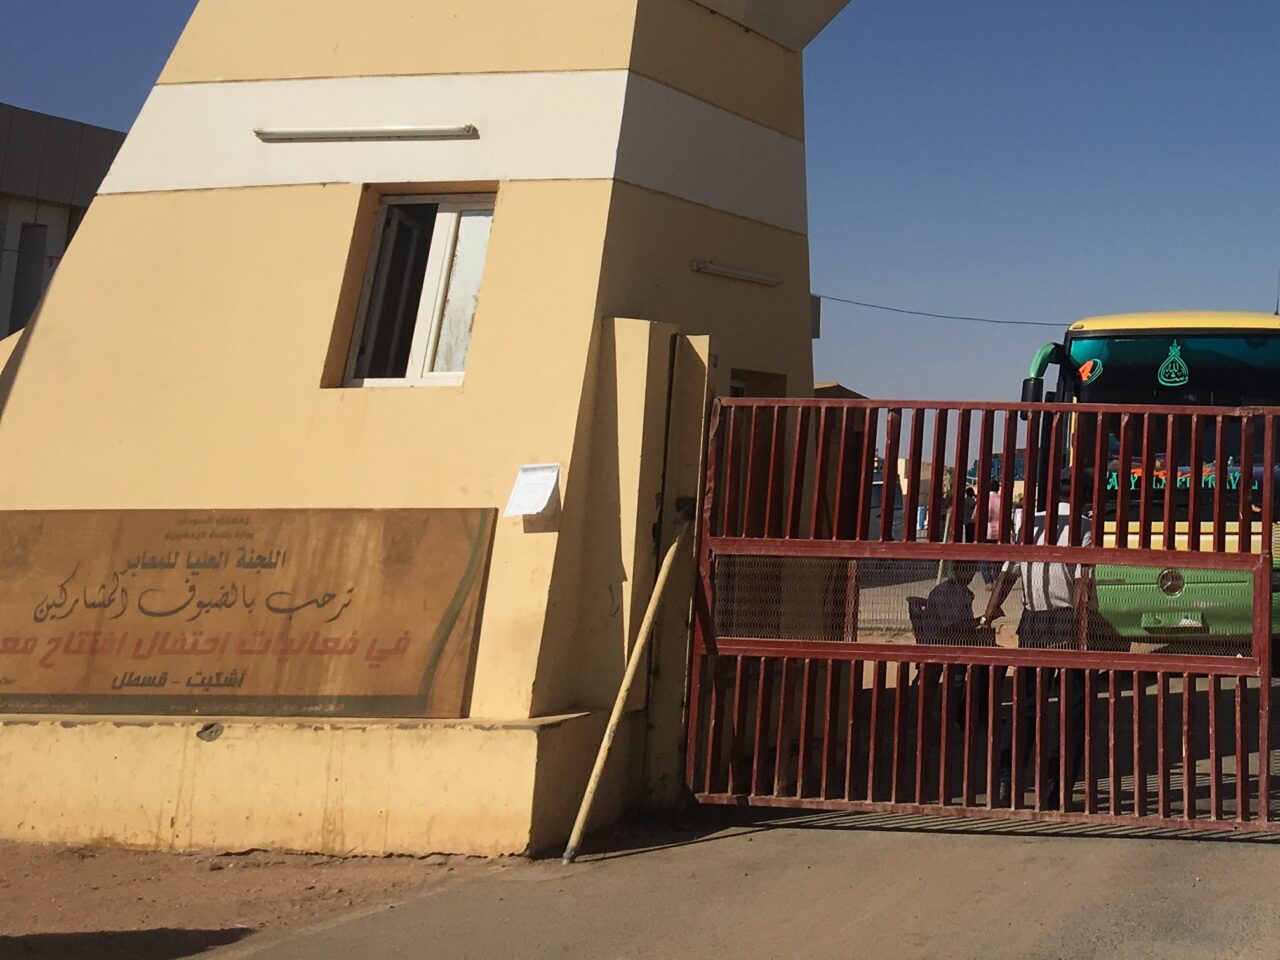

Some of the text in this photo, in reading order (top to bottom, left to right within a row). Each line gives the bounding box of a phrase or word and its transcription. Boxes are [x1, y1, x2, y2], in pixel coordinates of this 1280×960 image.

[119, 547, 287, 577] اللجنة العليا للمعابر
[33, 560, 128, 623] المشاركين
[138, 578, 255, 622] بالضيوف
[236, 630, 360, 663] فعاليات
[365, 630, 411, 669] في
